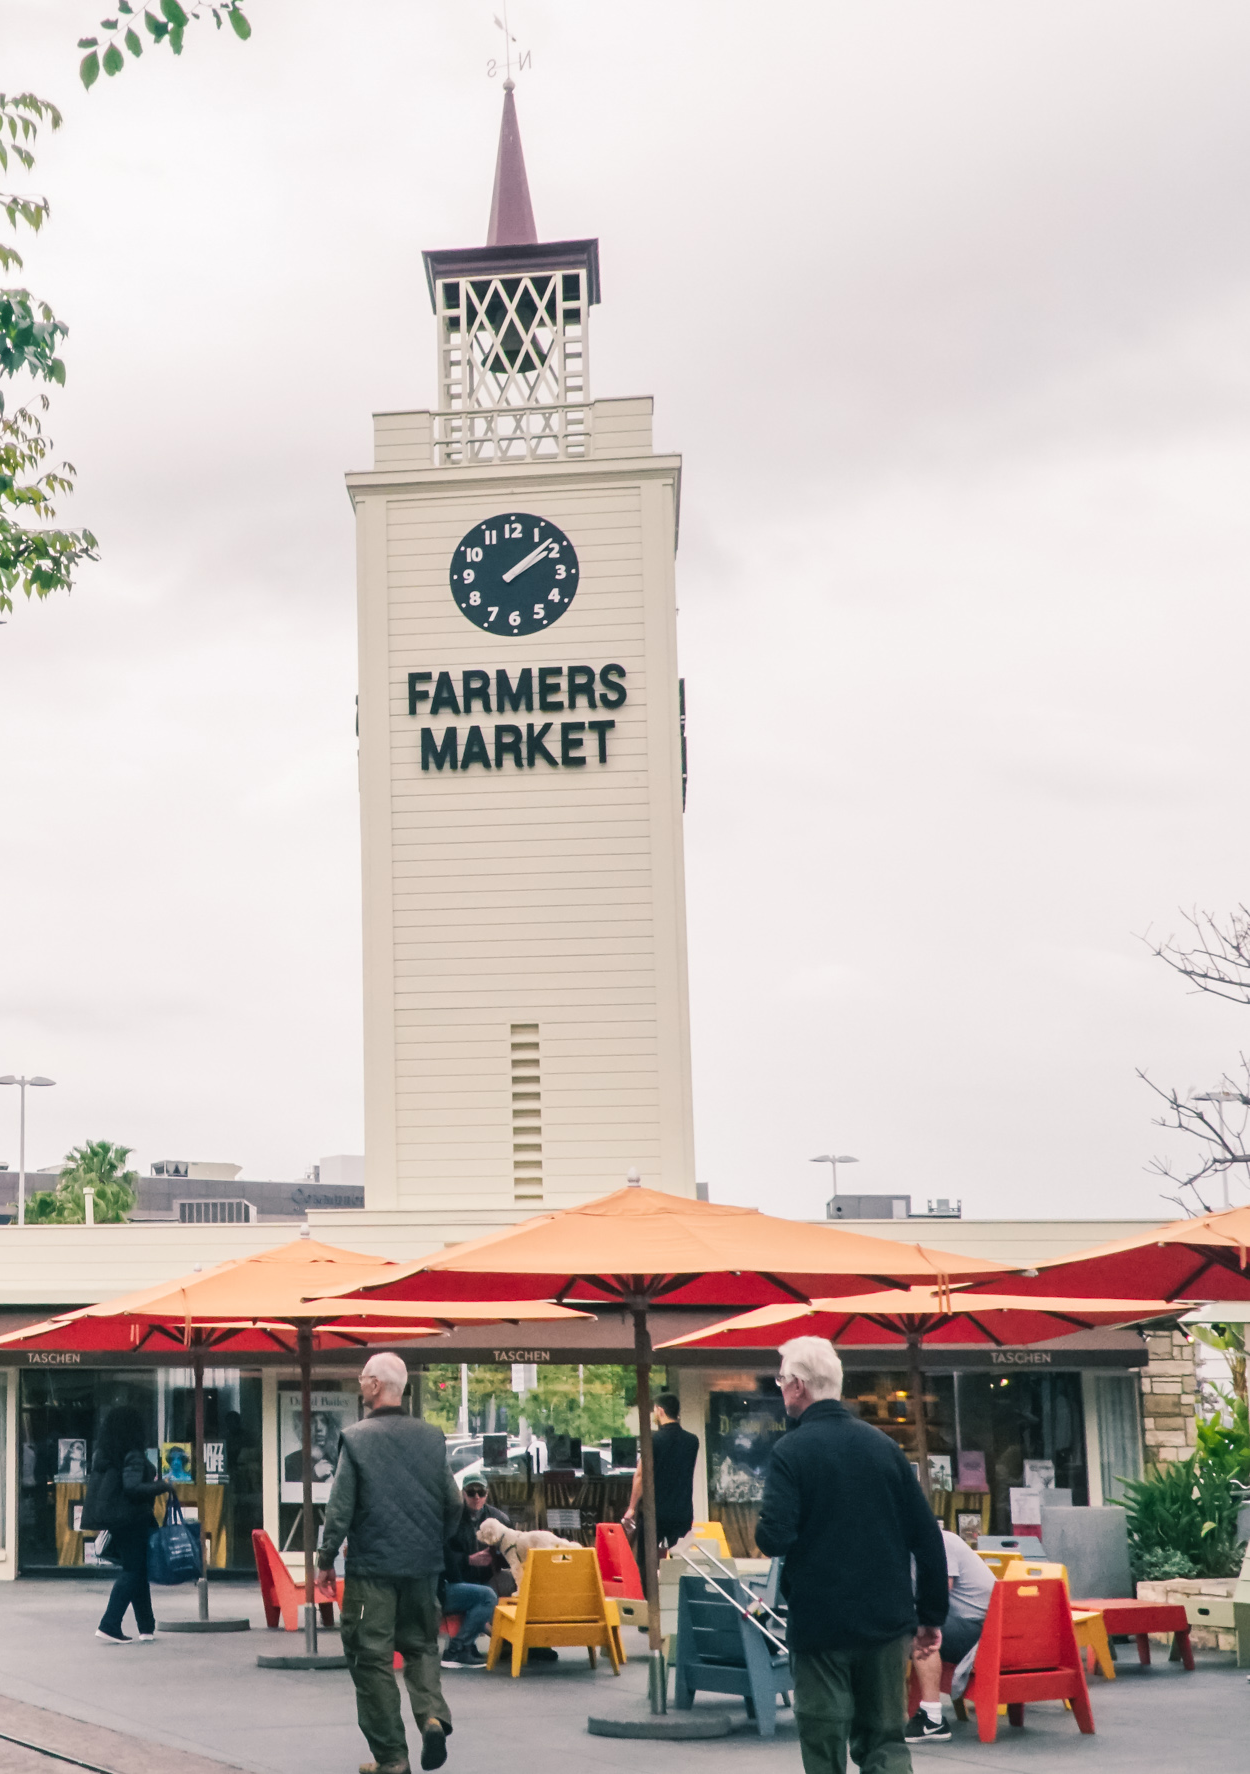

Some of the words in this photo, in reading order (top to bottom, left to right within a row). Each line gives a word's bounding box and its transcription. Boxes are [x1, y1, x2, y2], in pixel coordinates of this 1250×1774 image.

[485, 530, 497, 545] 11
[504, 523, 523, 539] 12
[533, 527, 540, 543] 1
[466, 547, 483, 562] 10
[548, 543, 560, 558] 2
[463, 569, 475, 584] 9
[555, 564, 567, 580] 3
[469, 591, 481, 606] 8
[548, 588, 561, 603] 4
[487, 606, 499, 622] 7
[508, 611, 521, 626] 6
[533, 604, 545, 619] 5
[408, 663, 627, 715] FARMERS
[421, 719, 615, 771] MARKET
[27, 1353, 80, 1363] TASCHEN
[493, 1350, 550, 1361] TASCHEN
[991, 1352, 1051, 1364] TASCHEN
